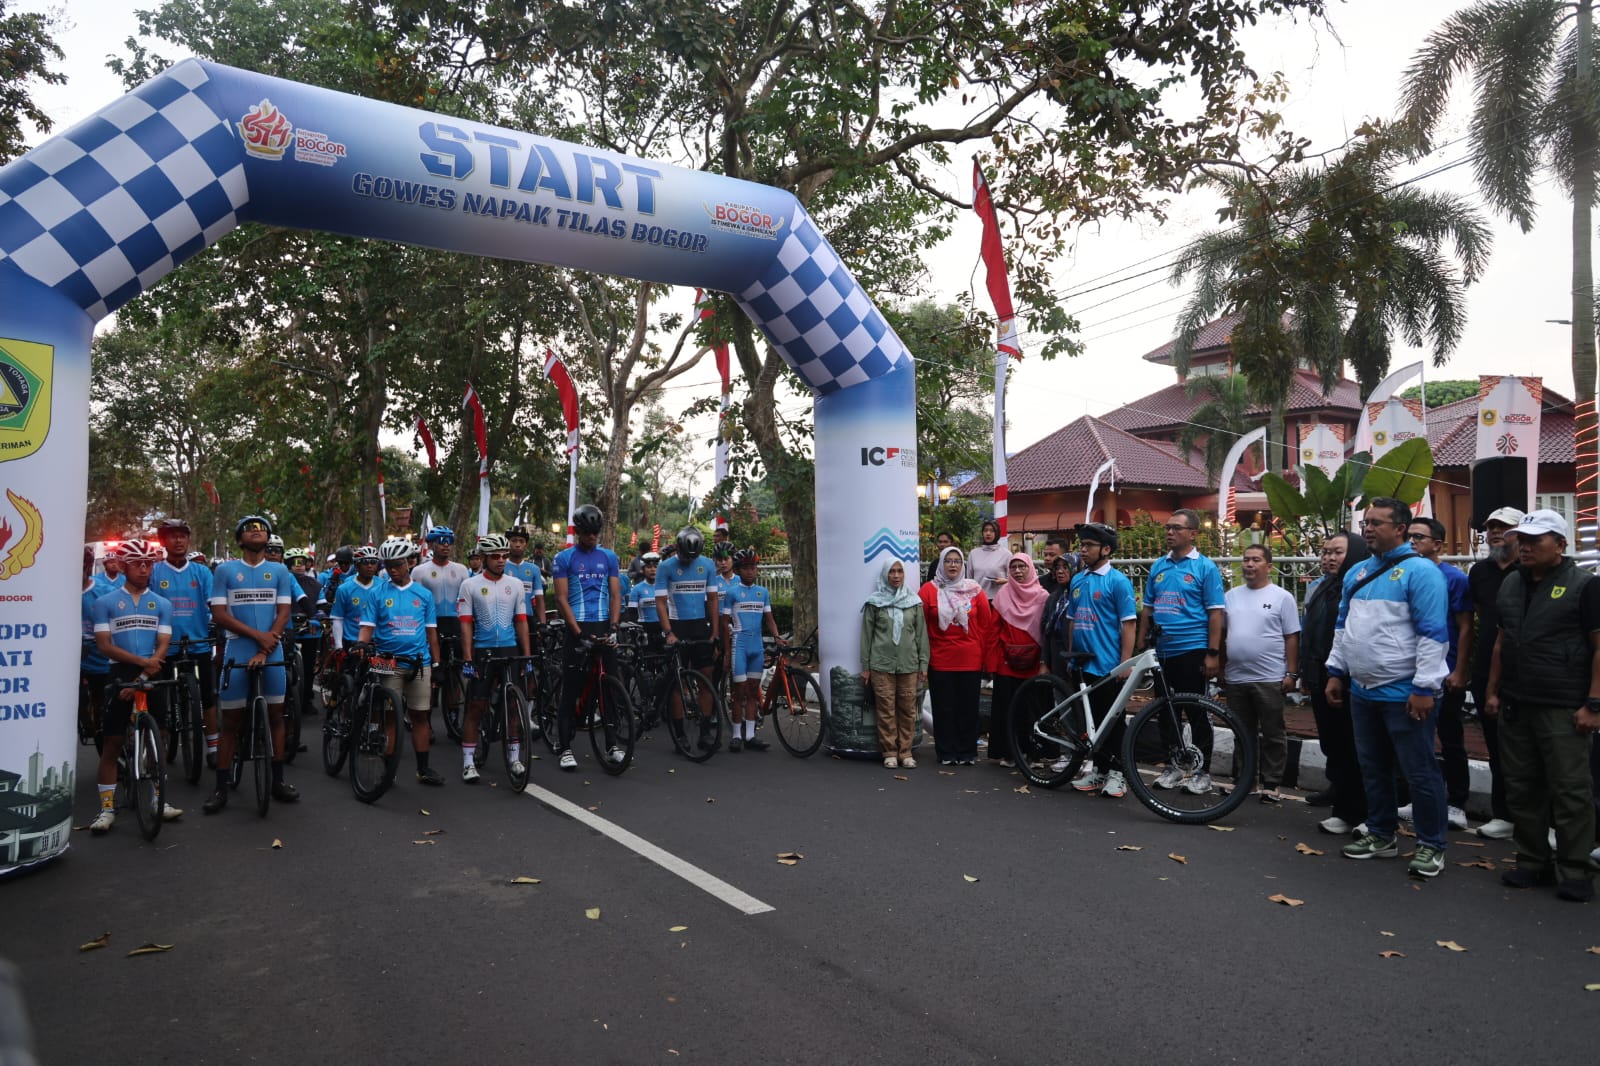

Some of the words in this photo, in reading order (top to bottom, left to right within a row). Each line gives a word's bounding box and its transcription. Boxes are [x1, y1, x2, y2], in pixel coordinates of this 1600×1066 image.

[297, 137, 345, 155] BOGOR
[418, 121, 662, 215] START
[352, 172, 456, 210] GOWES
[463, 192, 551, 226] NAPAK
[557, 208, 627, 239] TILAS
[631, 223, 709, 252] BOGOR
[725, 202, 760, 212] KABUPATEN
[716, 205, 772, 229] BOGOR
[711, 219, 740, 229] ISTIMEWA
[747, 226, 777, 236] GEMILANG
[9, 366, 29, 394] TOHAGA
[1, 440, 32, 449] RIMAN
[0, 623, 47, 640] OPO
